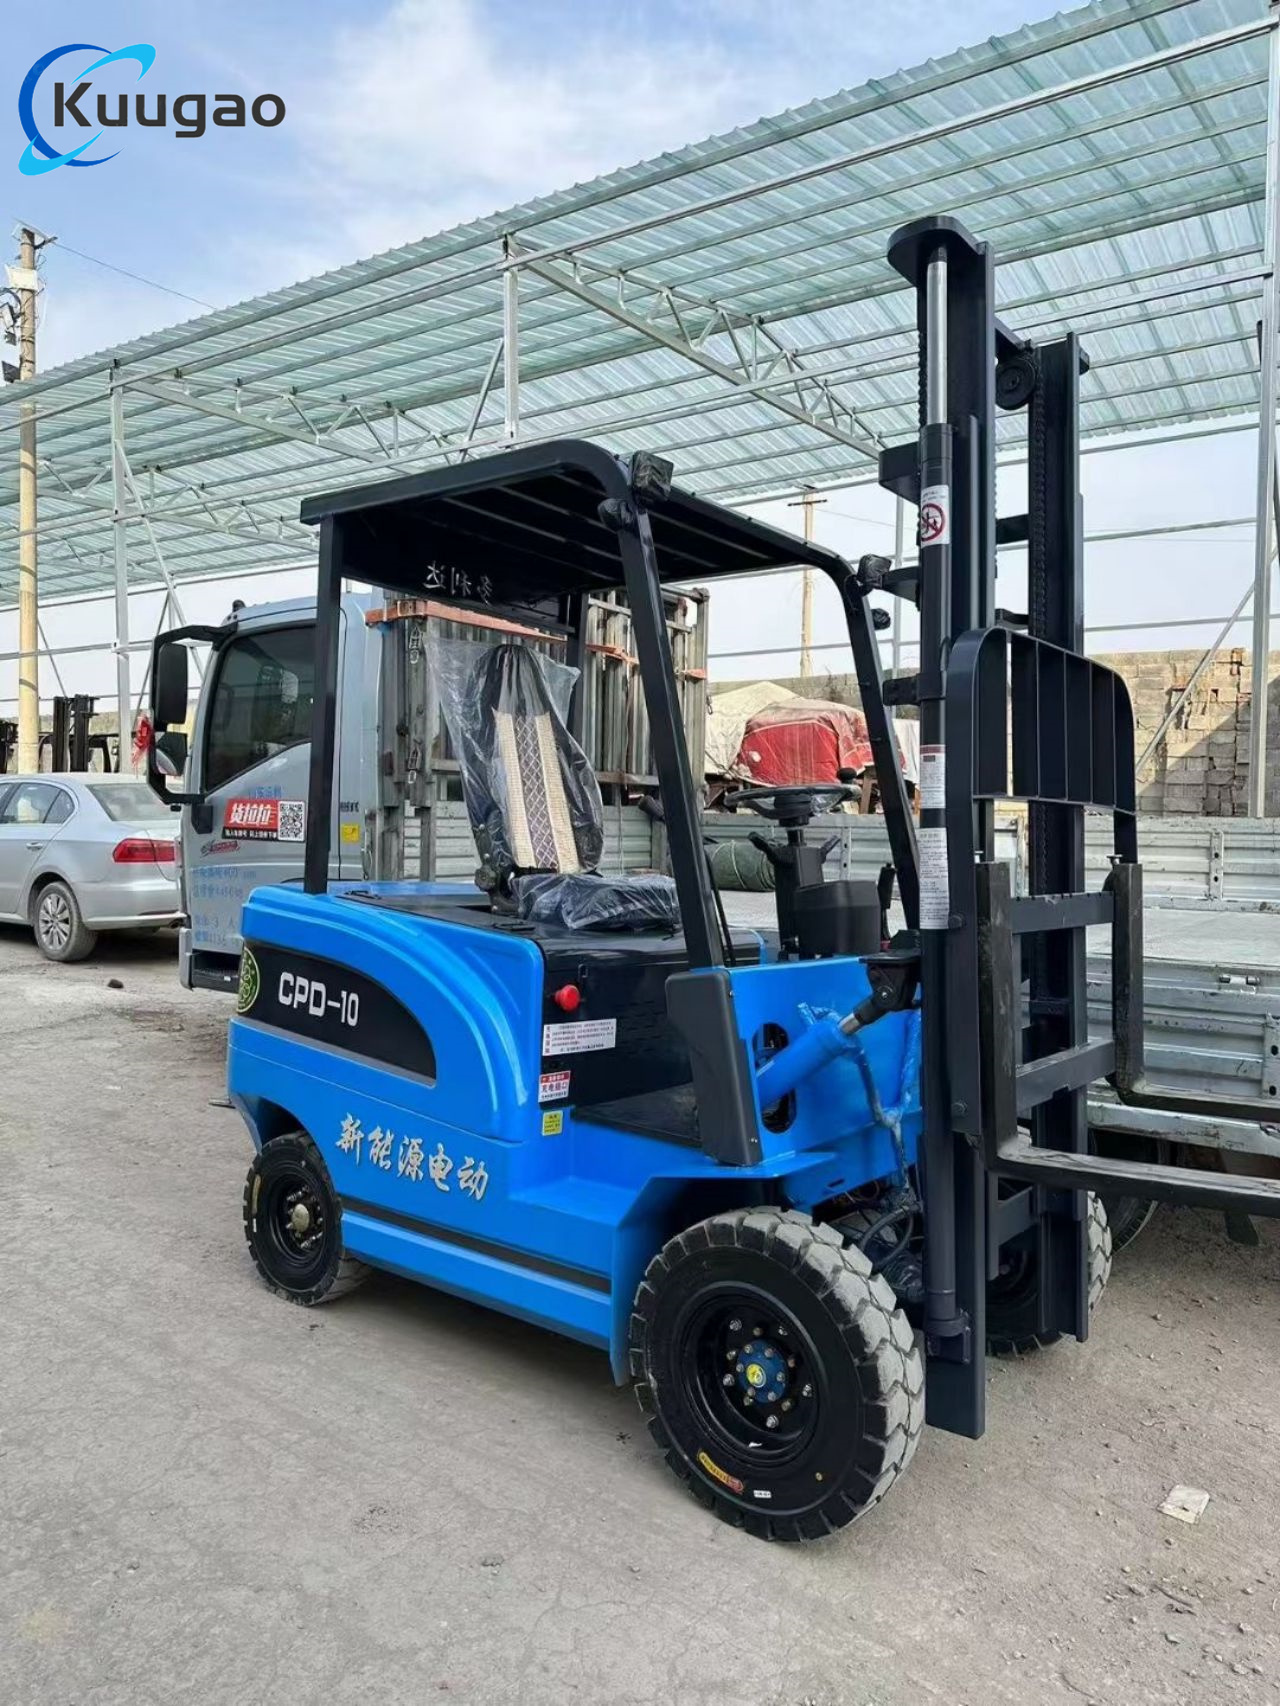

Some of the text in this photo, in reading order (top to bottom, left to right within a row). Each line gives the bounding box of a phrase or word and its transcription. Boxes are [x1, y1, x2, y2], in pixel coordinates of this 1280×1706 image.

[230, 803, 272, 826] 货拉拉
[278, 971, 359, 1027] CPD-10
[336, 1112, 489, 1200] 新能源电动
